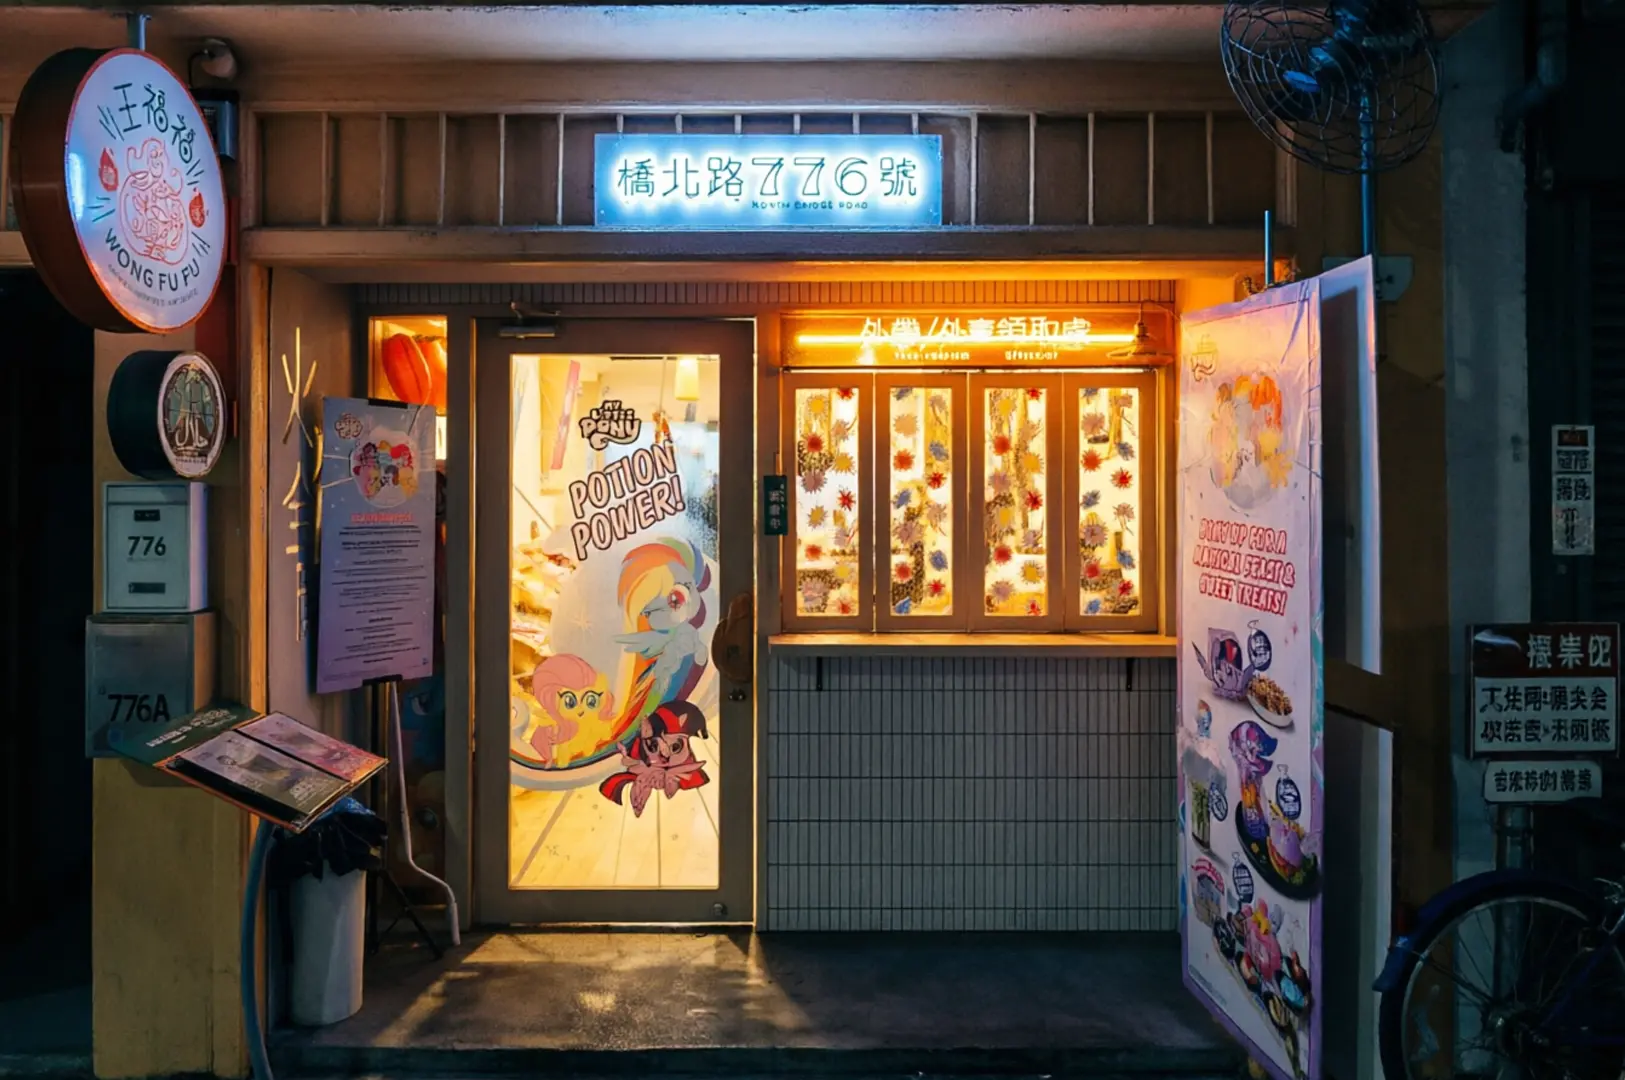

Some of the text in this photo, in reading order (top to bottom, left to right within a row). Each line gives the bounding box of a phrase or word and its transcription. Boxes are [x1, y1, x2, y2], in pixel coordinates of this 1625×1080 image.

[617, 156, 917, 197] 橋北路776號
[105, 227, 154, 288] WONG
[159, 273, 178, 292] FU
[181, 258, 200, 287] FU
[569, 439, 678, 519] POTION
[571, 474, 686, 561] POWER!
[127, 535, 167, 557] 776
[108, 693, 170, 723] 776A
